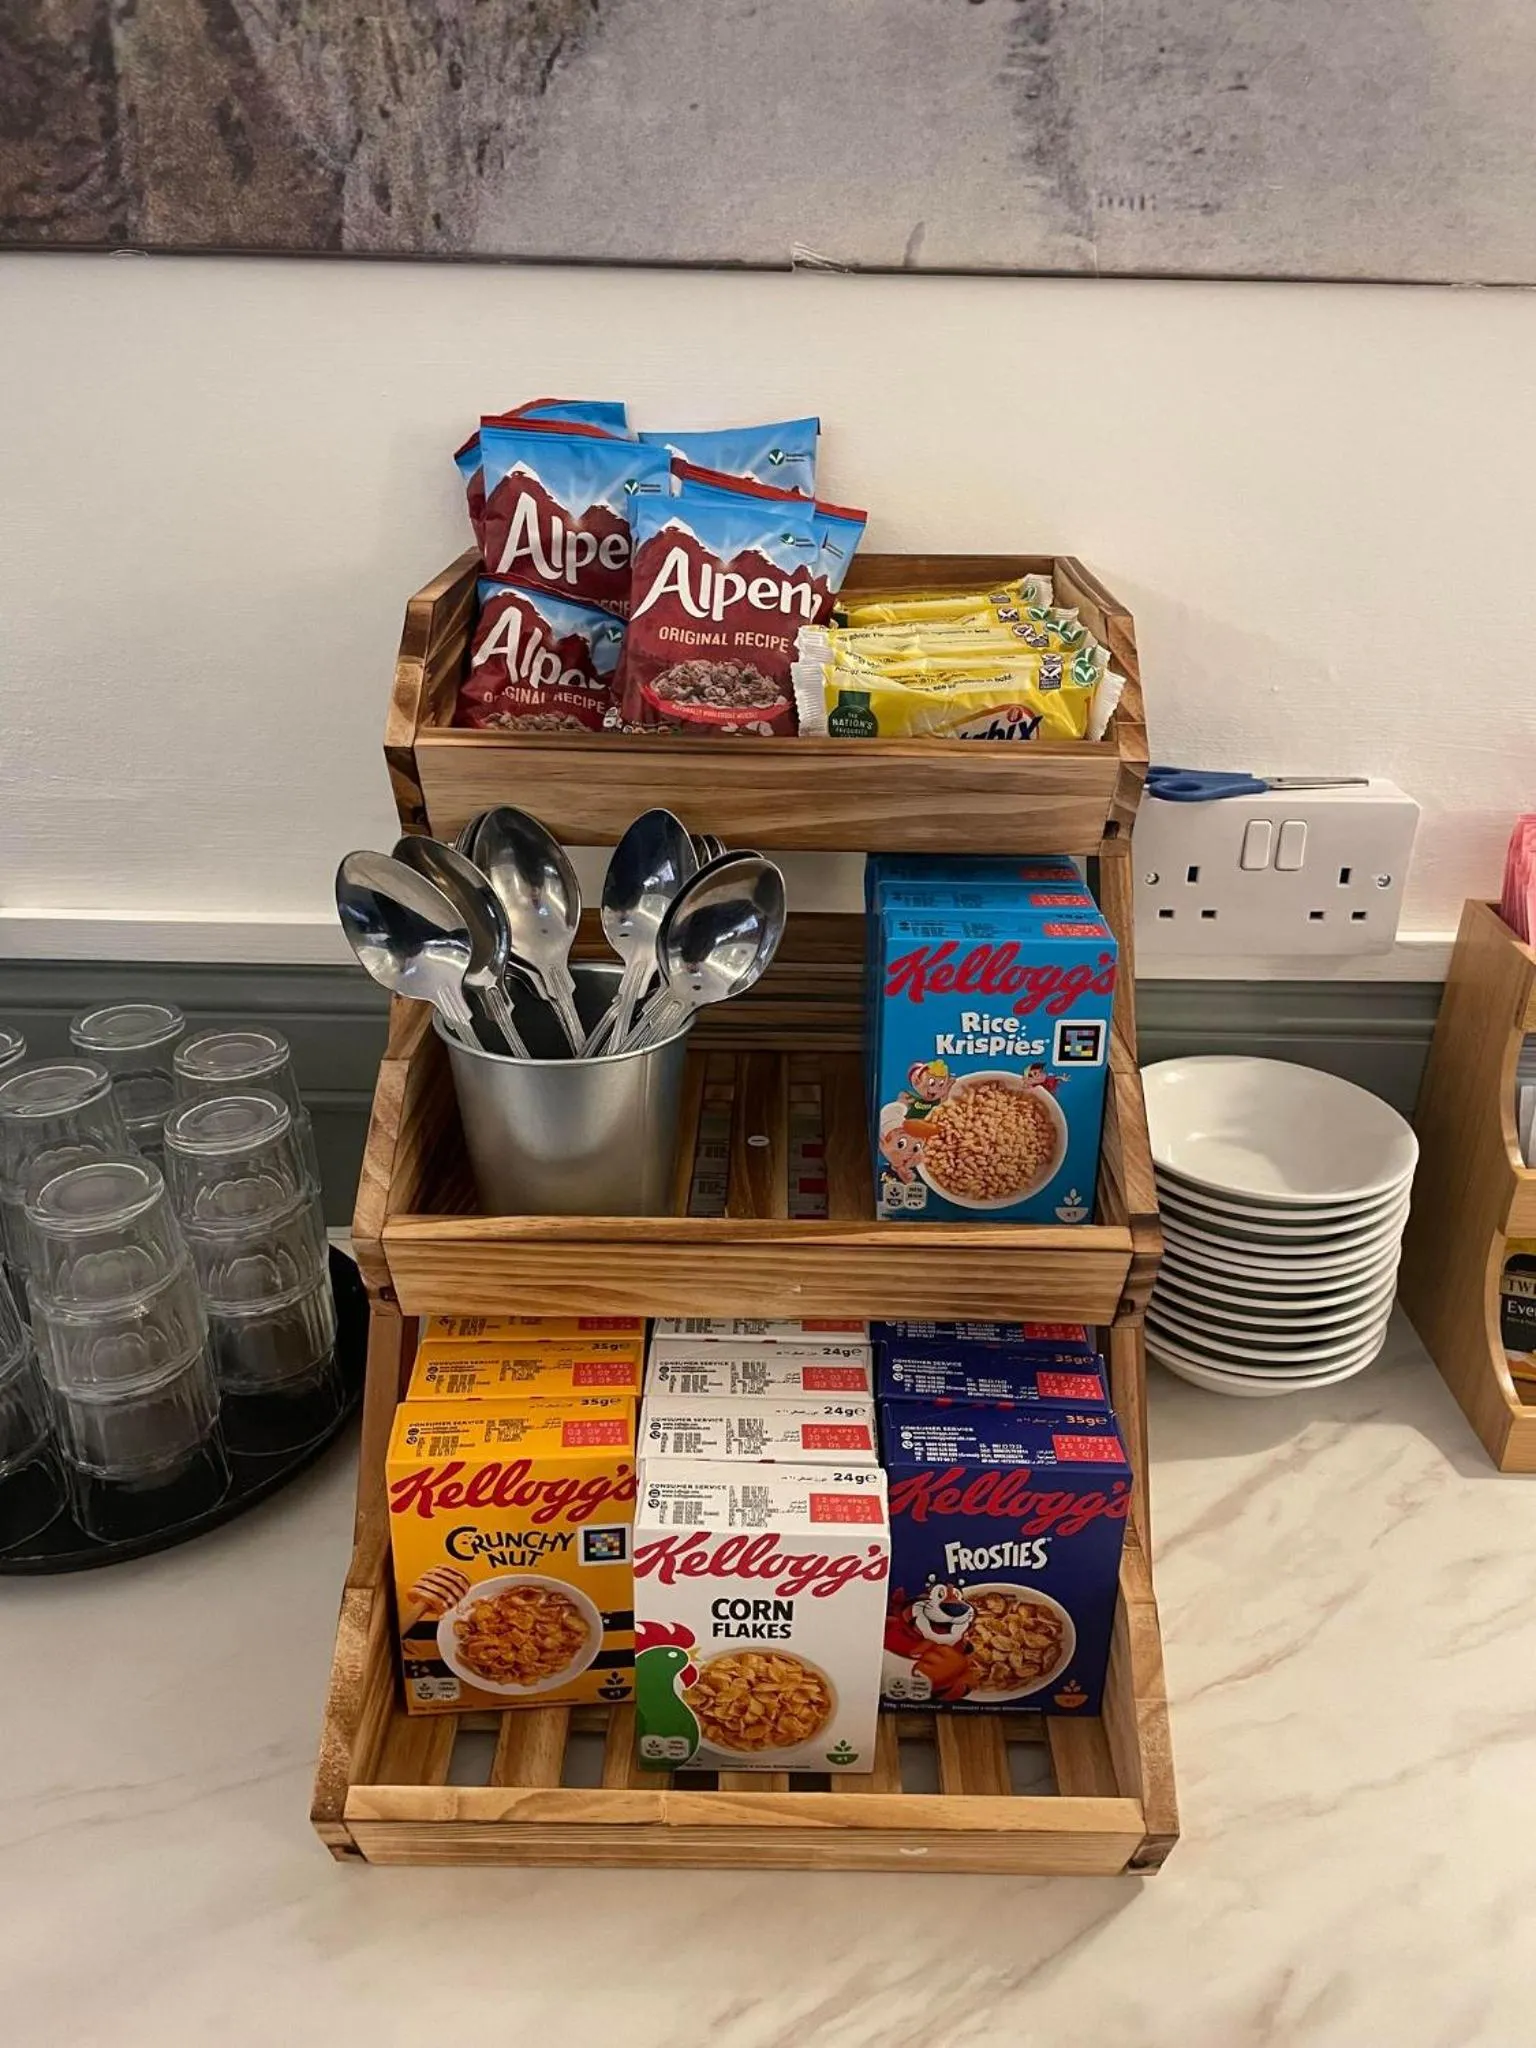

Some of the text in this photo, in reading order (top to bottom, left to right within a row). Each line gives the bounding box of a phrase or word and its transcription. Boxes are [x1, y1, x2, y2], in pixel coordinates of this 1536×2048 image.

[496, 492, 631, 584] Alpe
[631, 546, 813, 621] Alpen
[659, 626, 790, 654] ORIGINAL RECIPE
[832, 718, 874, 730] NATION'S
[883, 940, 1118, 1017] Kellogg's
[960, 1011, 1020, 1034] Rice
[935, 1034, 1048, 1057] Krispies
[1507, 1300, 1536, 1316] Eve
[389, 1458, 640, 1524] Kellogg's
[889, 1467, 1132, 1537] Kellogg's
[445, 1526, 575, 1562] CRUNCHY
[488, 1549, 543, 1568] NUT
[944, 1537, 1049, 1574] FROSTIES
[633, 1531, 890, 1597] Kellogg's
[711, 1597, 794, 1621] CORN
[712, 1622, 793, 1639] FLAKES
